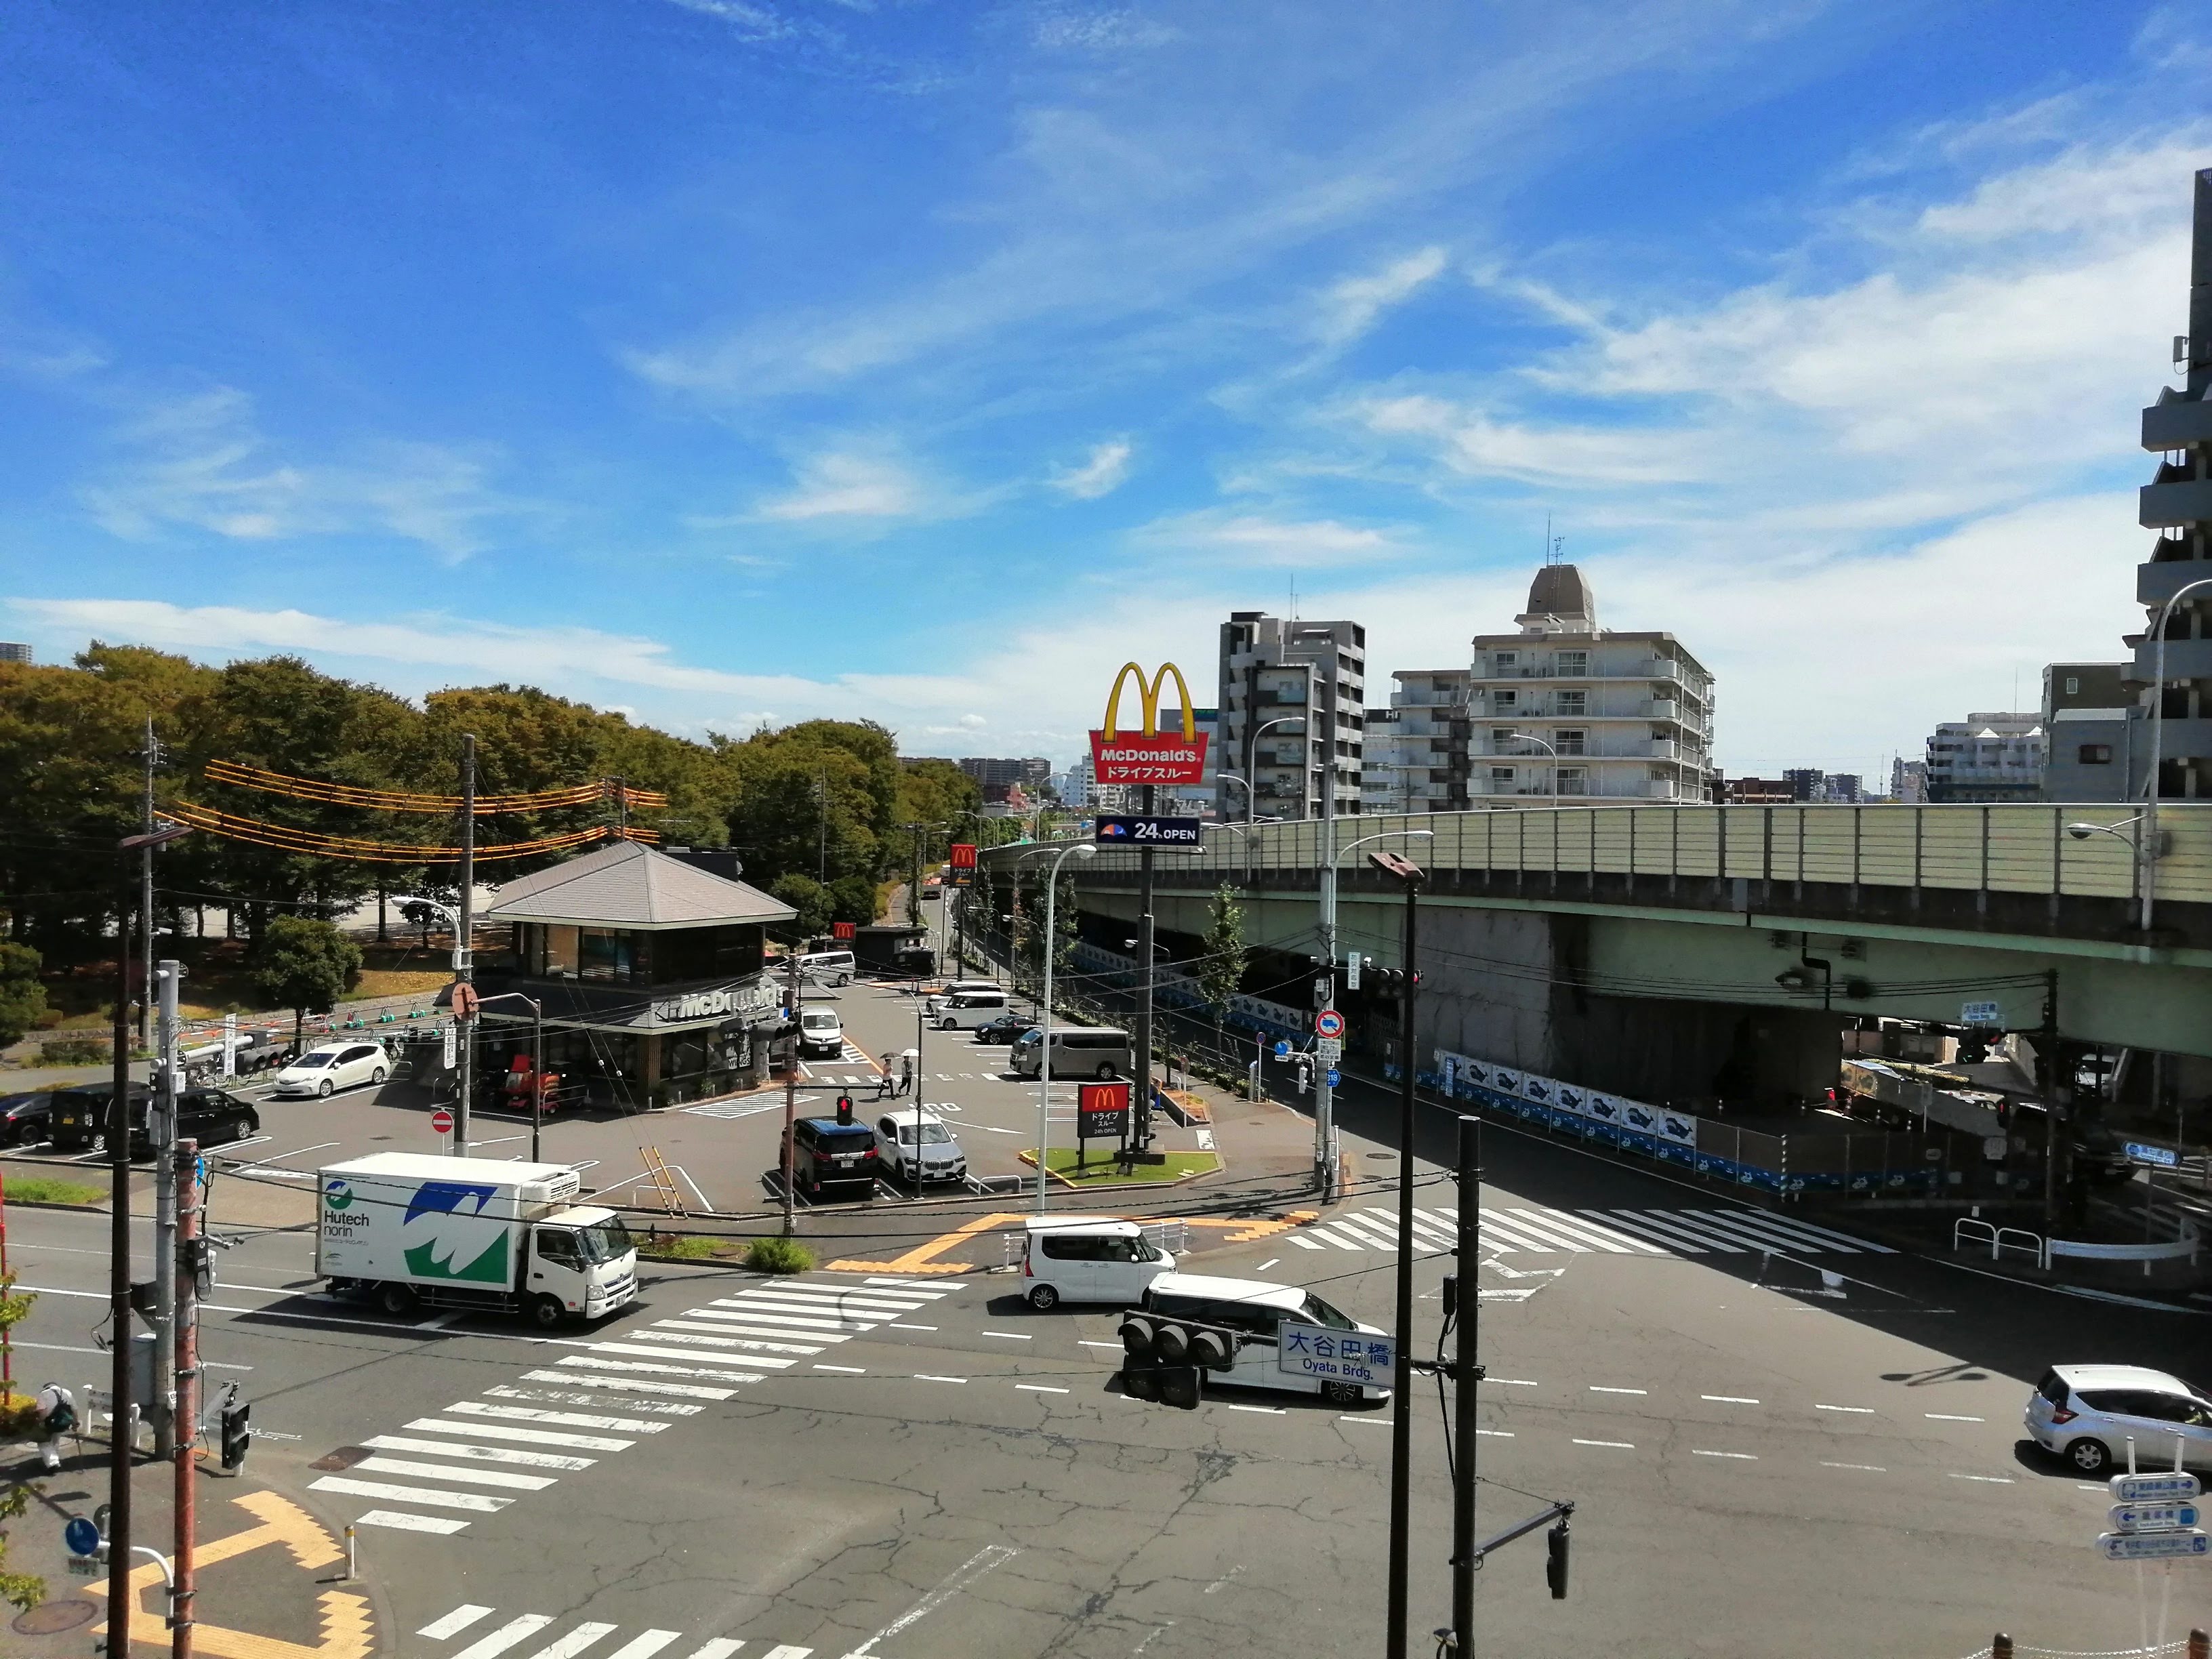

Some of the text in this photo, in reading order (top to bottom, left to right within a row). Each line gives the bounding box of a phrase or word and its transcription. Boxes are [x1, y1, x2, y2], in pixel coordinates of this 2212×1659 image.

[1101, 749, 1196, 762] McDonald's
[1107, 766, 1192, 779] ドライブスルー
[1134, 822, 1195, 840] 24h OPEN
[1092, 1111, 1119, 1121] ドライブ
[324, 1210, 369, 1226] Hutech
[324, 1225, 352, 1237] norin
[1288, 1331, 1389, 1366] 大谷田橋
[1303, 1357, 1374, 1380] Oyata Brdg.
